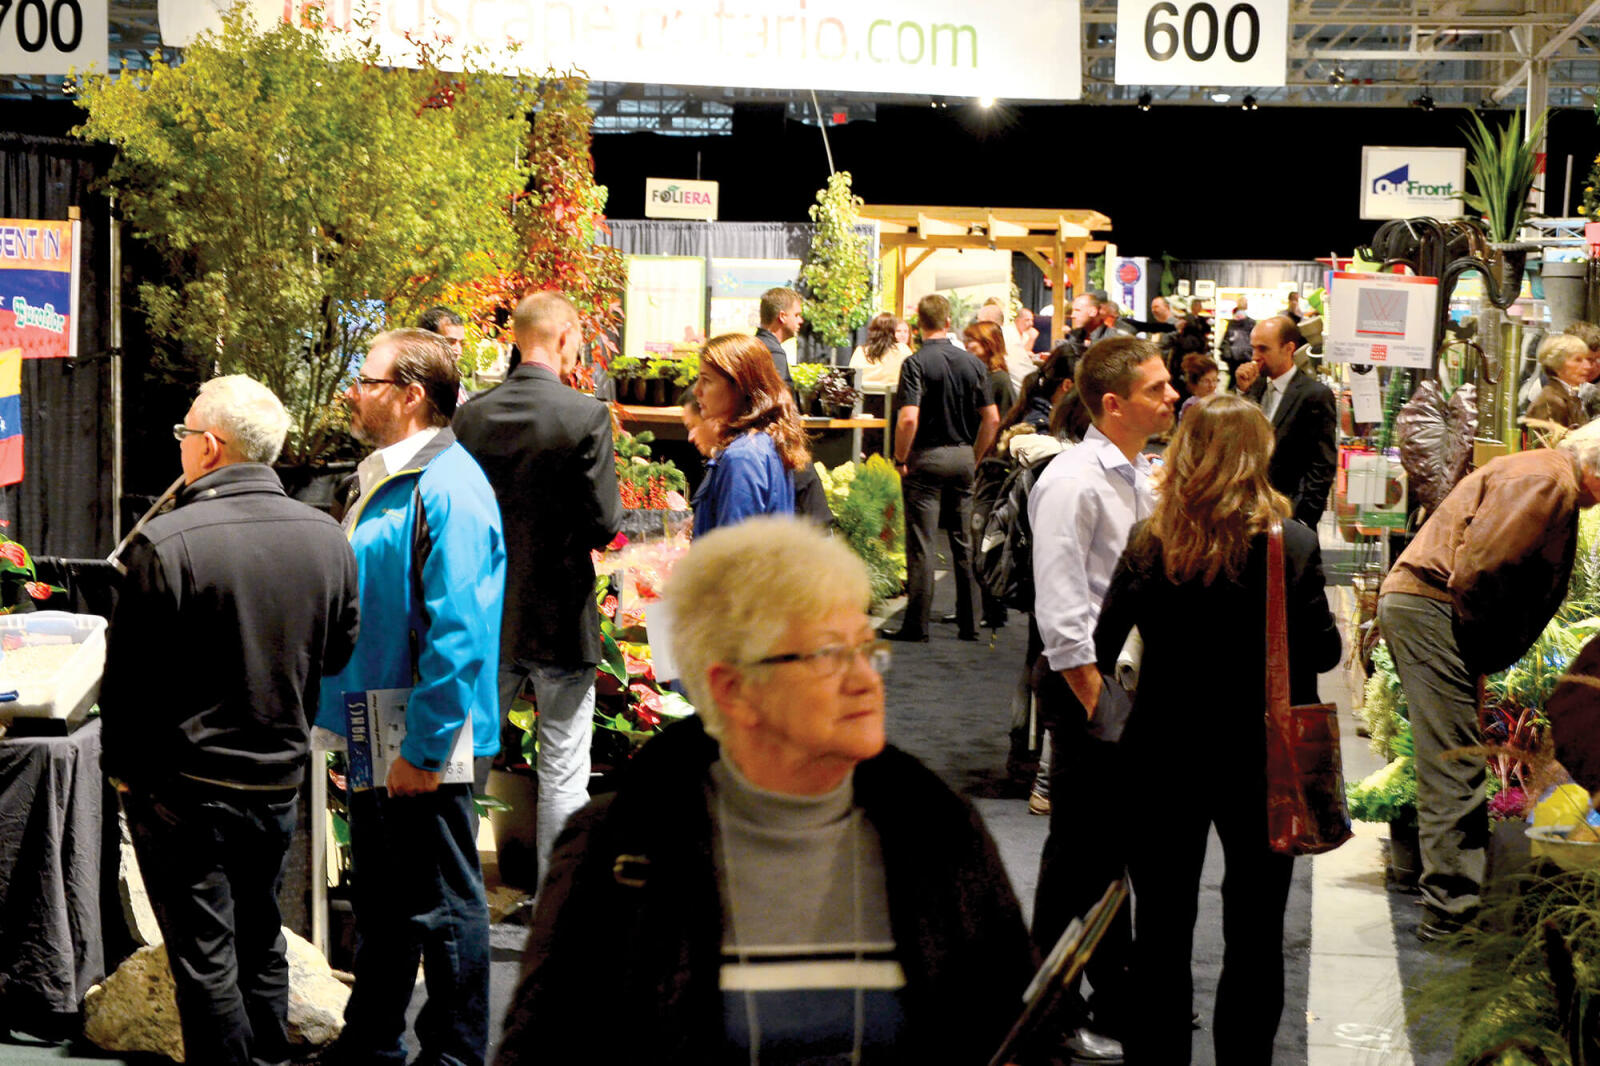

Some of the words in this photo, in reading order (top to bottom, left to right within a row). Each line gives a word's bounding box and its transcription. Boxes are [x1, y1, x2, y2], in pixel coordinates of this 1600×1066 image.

[1144, 1, 1260, 63] 600
[652, 189, 712, 205] FOLIERA
[0, 227, 38, 258] ENT
